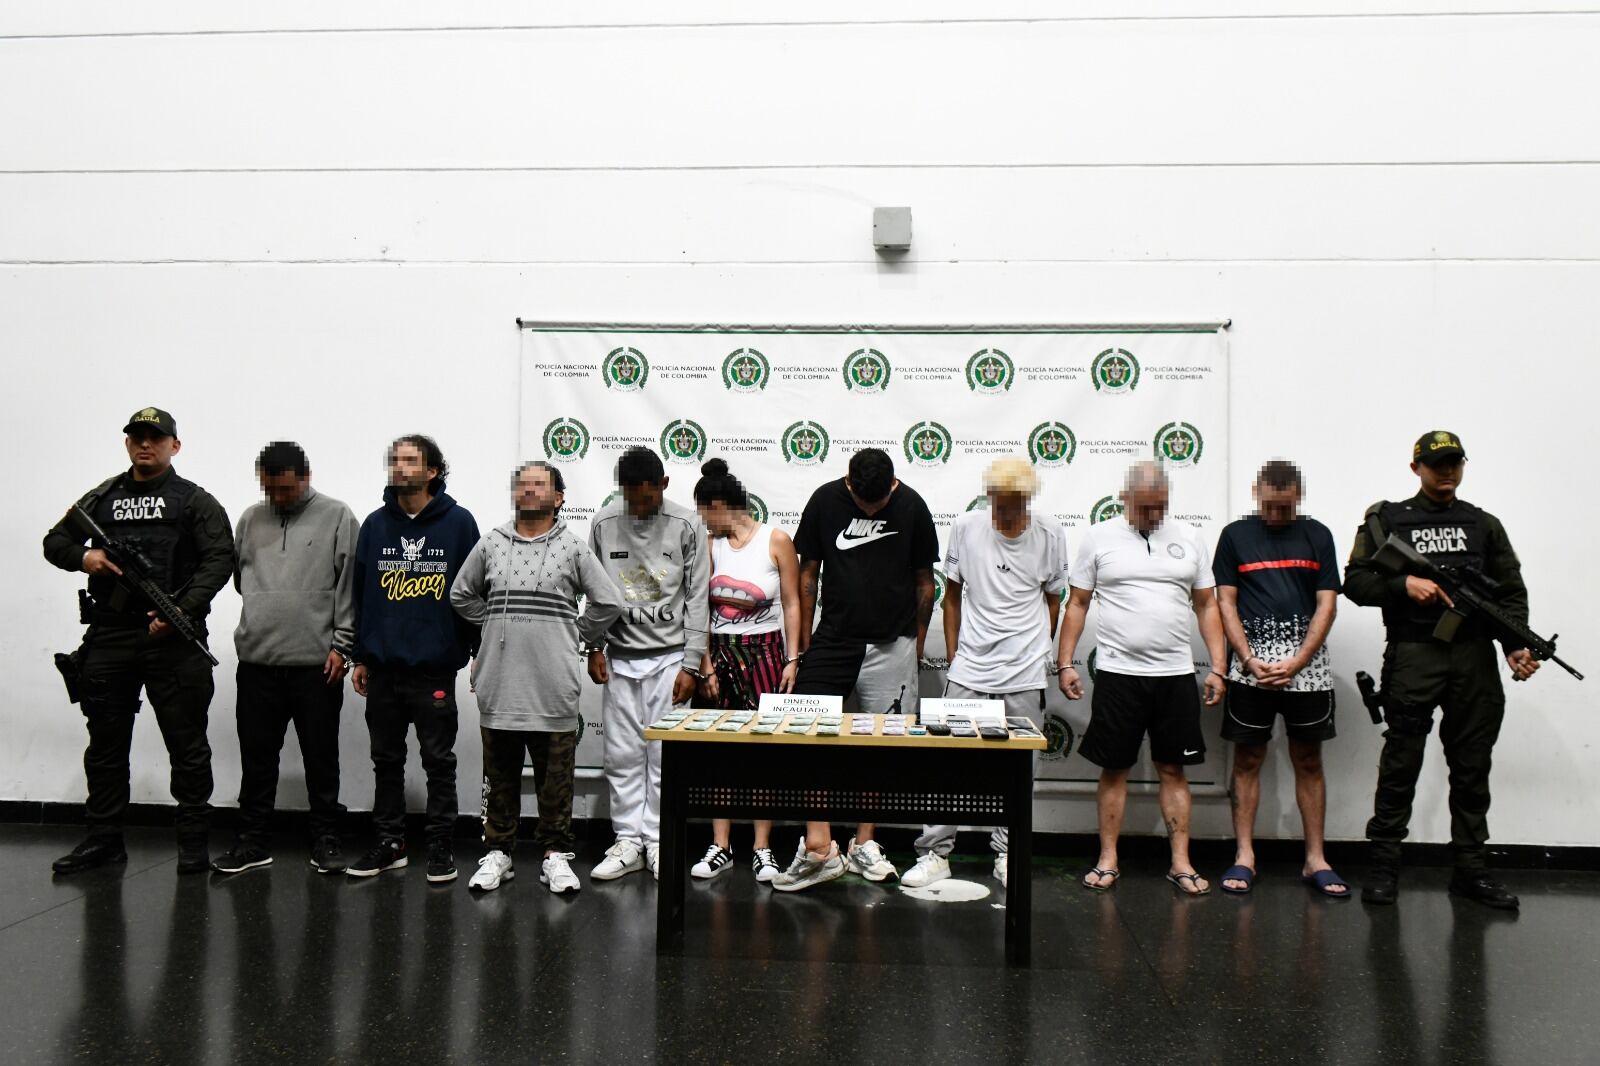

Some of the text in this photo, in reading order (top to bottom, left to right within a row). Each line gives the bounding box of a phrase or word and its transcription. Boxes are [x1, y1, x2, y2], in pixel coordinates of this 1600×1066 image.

[1430, 441, 1458, 450] GAULA
[112, 496, 166, 510] POLICIA
[114, 507, 162, 520] GAULA
[844, 518, 887, 537] NIKE
[1411, 528, 1468, 542] POLICIA
[1415, 538, 1468, 554] GAULA
[378, 560, 448, 572] UNITED STATES
[381, 570, 446, 600] Navy
[622, 603, 674, 624] ING
[773, 706, 829, 714] INCAUTADO
